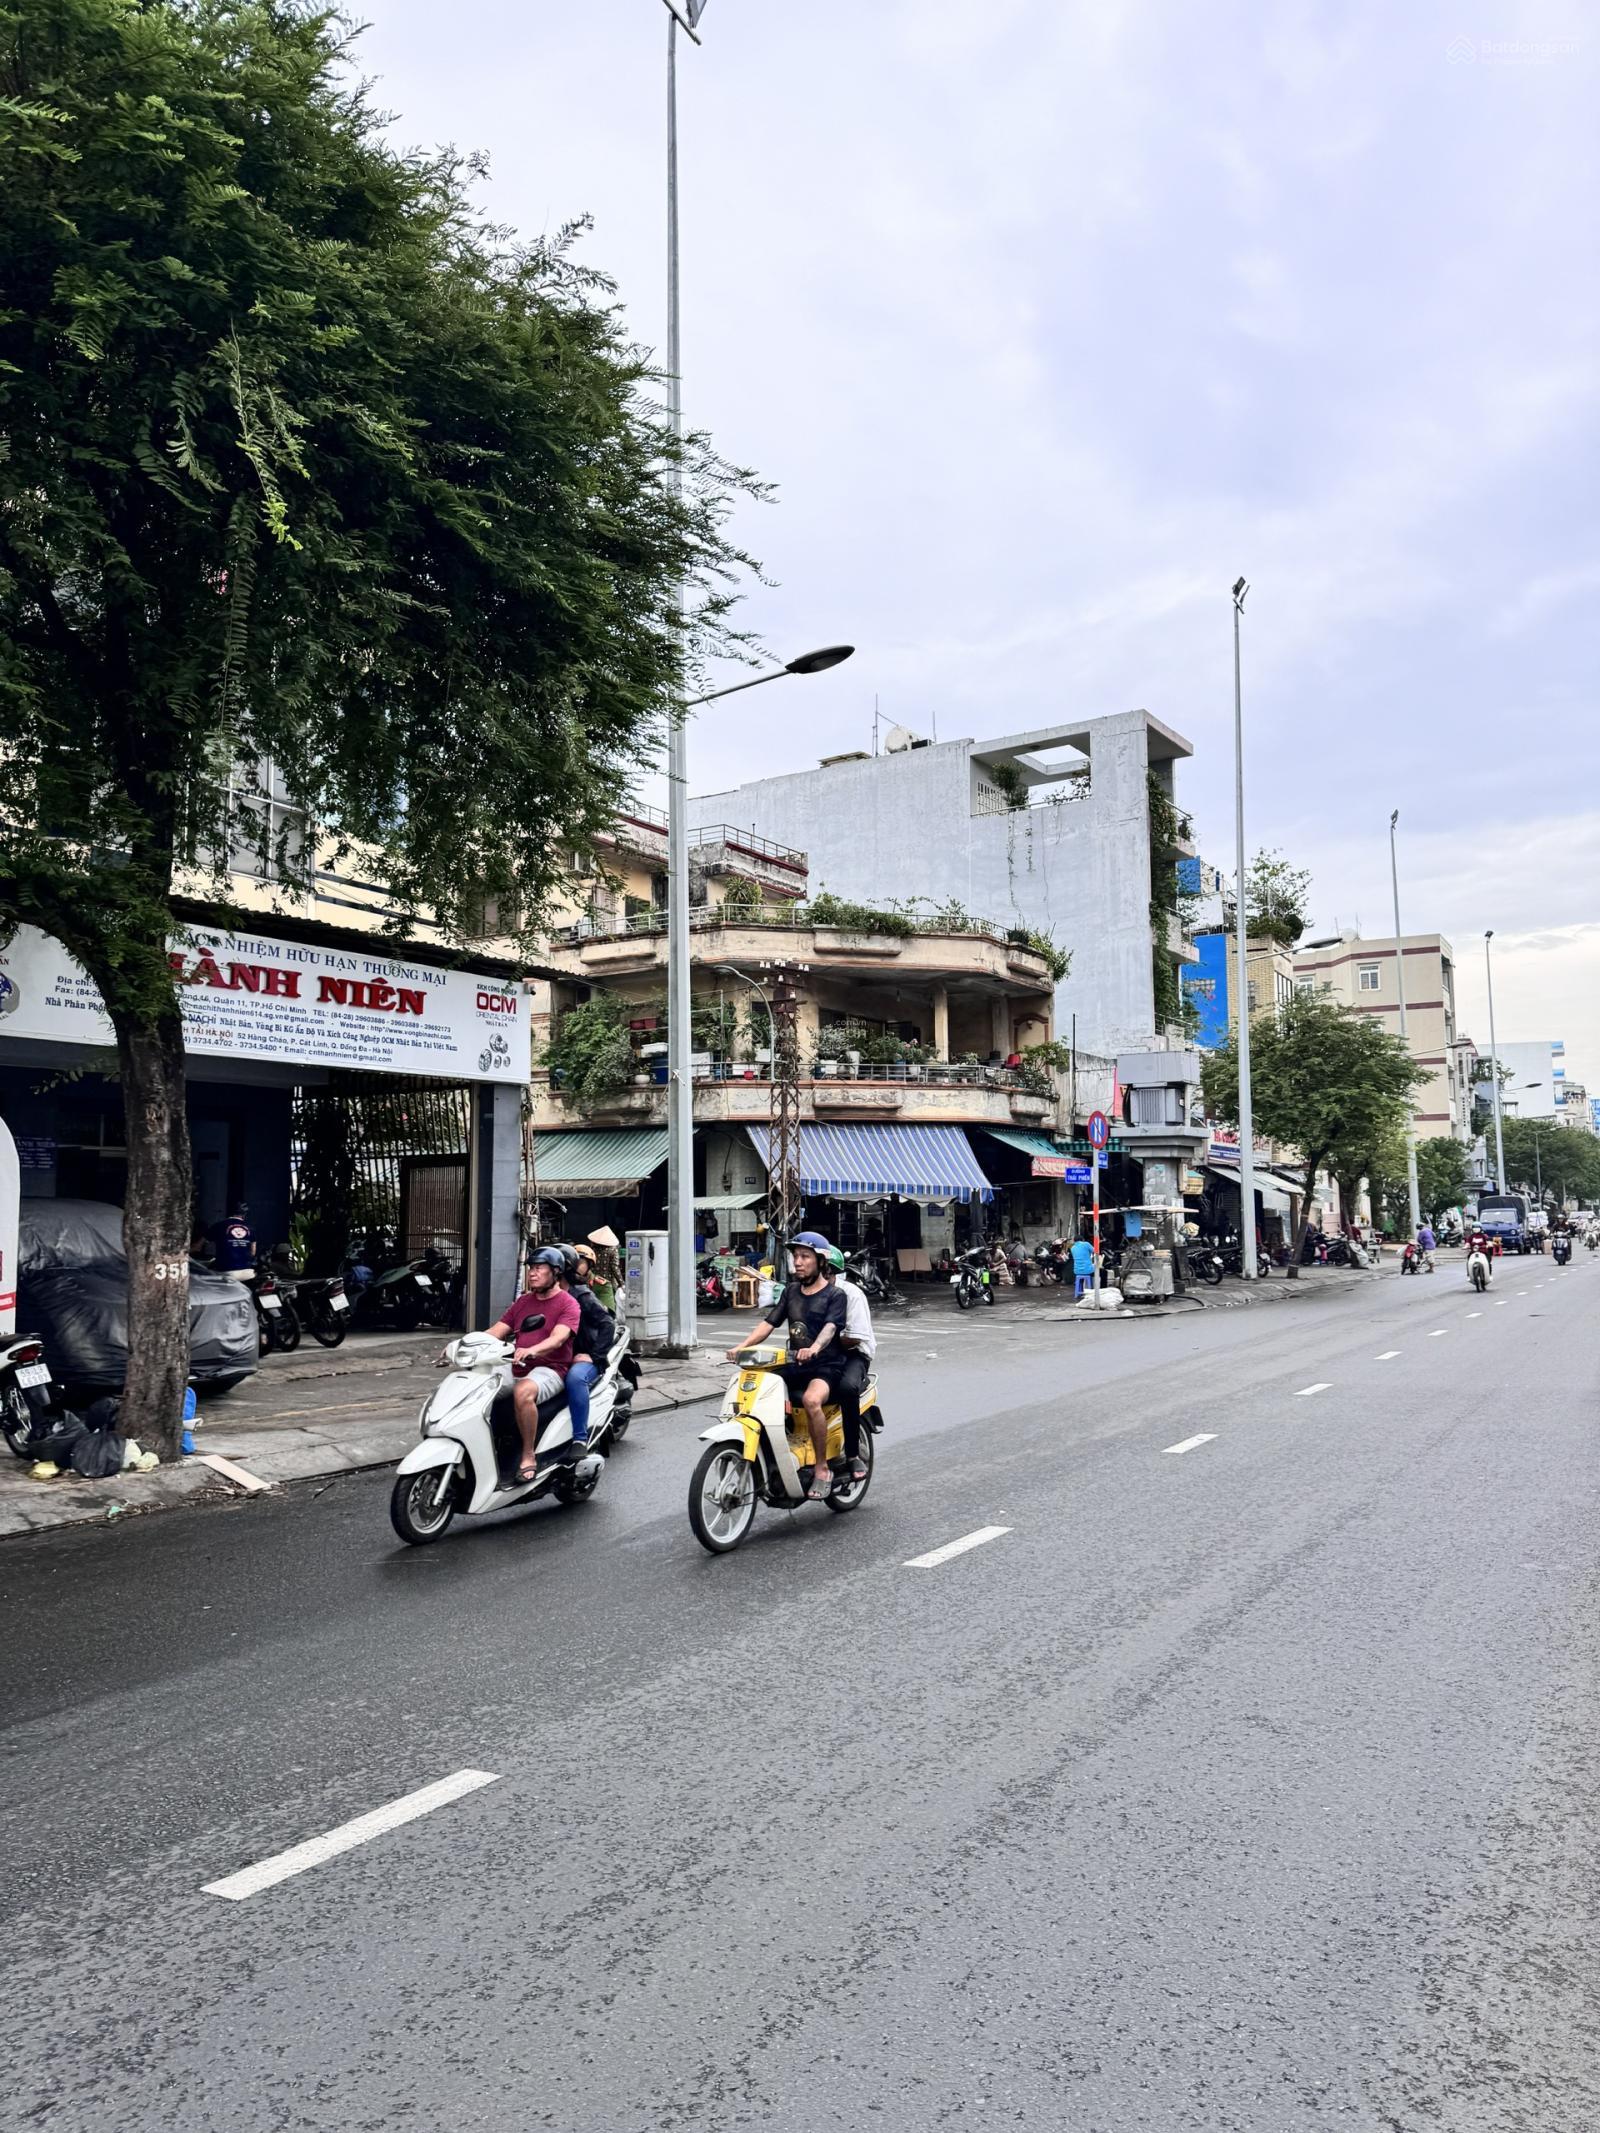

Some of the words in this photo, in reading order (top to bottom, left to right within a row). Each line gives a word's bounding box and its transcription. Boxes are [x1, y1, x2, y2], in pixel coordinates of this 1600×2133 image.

[224, 938, 281, 958] NHIỆM
[287, 948, 320, 964] HỮU
[325, 954, 357, 971] HẠN
[363, 961, 418, 980] THƯƠNG
[422, 971, 447, 987] MẠI
[57, 975, 73, 986] Địa
[55, 985, 73, 995] Fax:
[316, 975, 428, 1016] NIÊN
[45, 997, 61, 1007] Nhà
[64, 999, 86, 1010] Phân
[476, 991, 517, 1014] OCM
[289, 1006, 307, 1015] Minh
[340, 1020, 365, 1030] Website
[237, 1032, 246, 1040] 52
